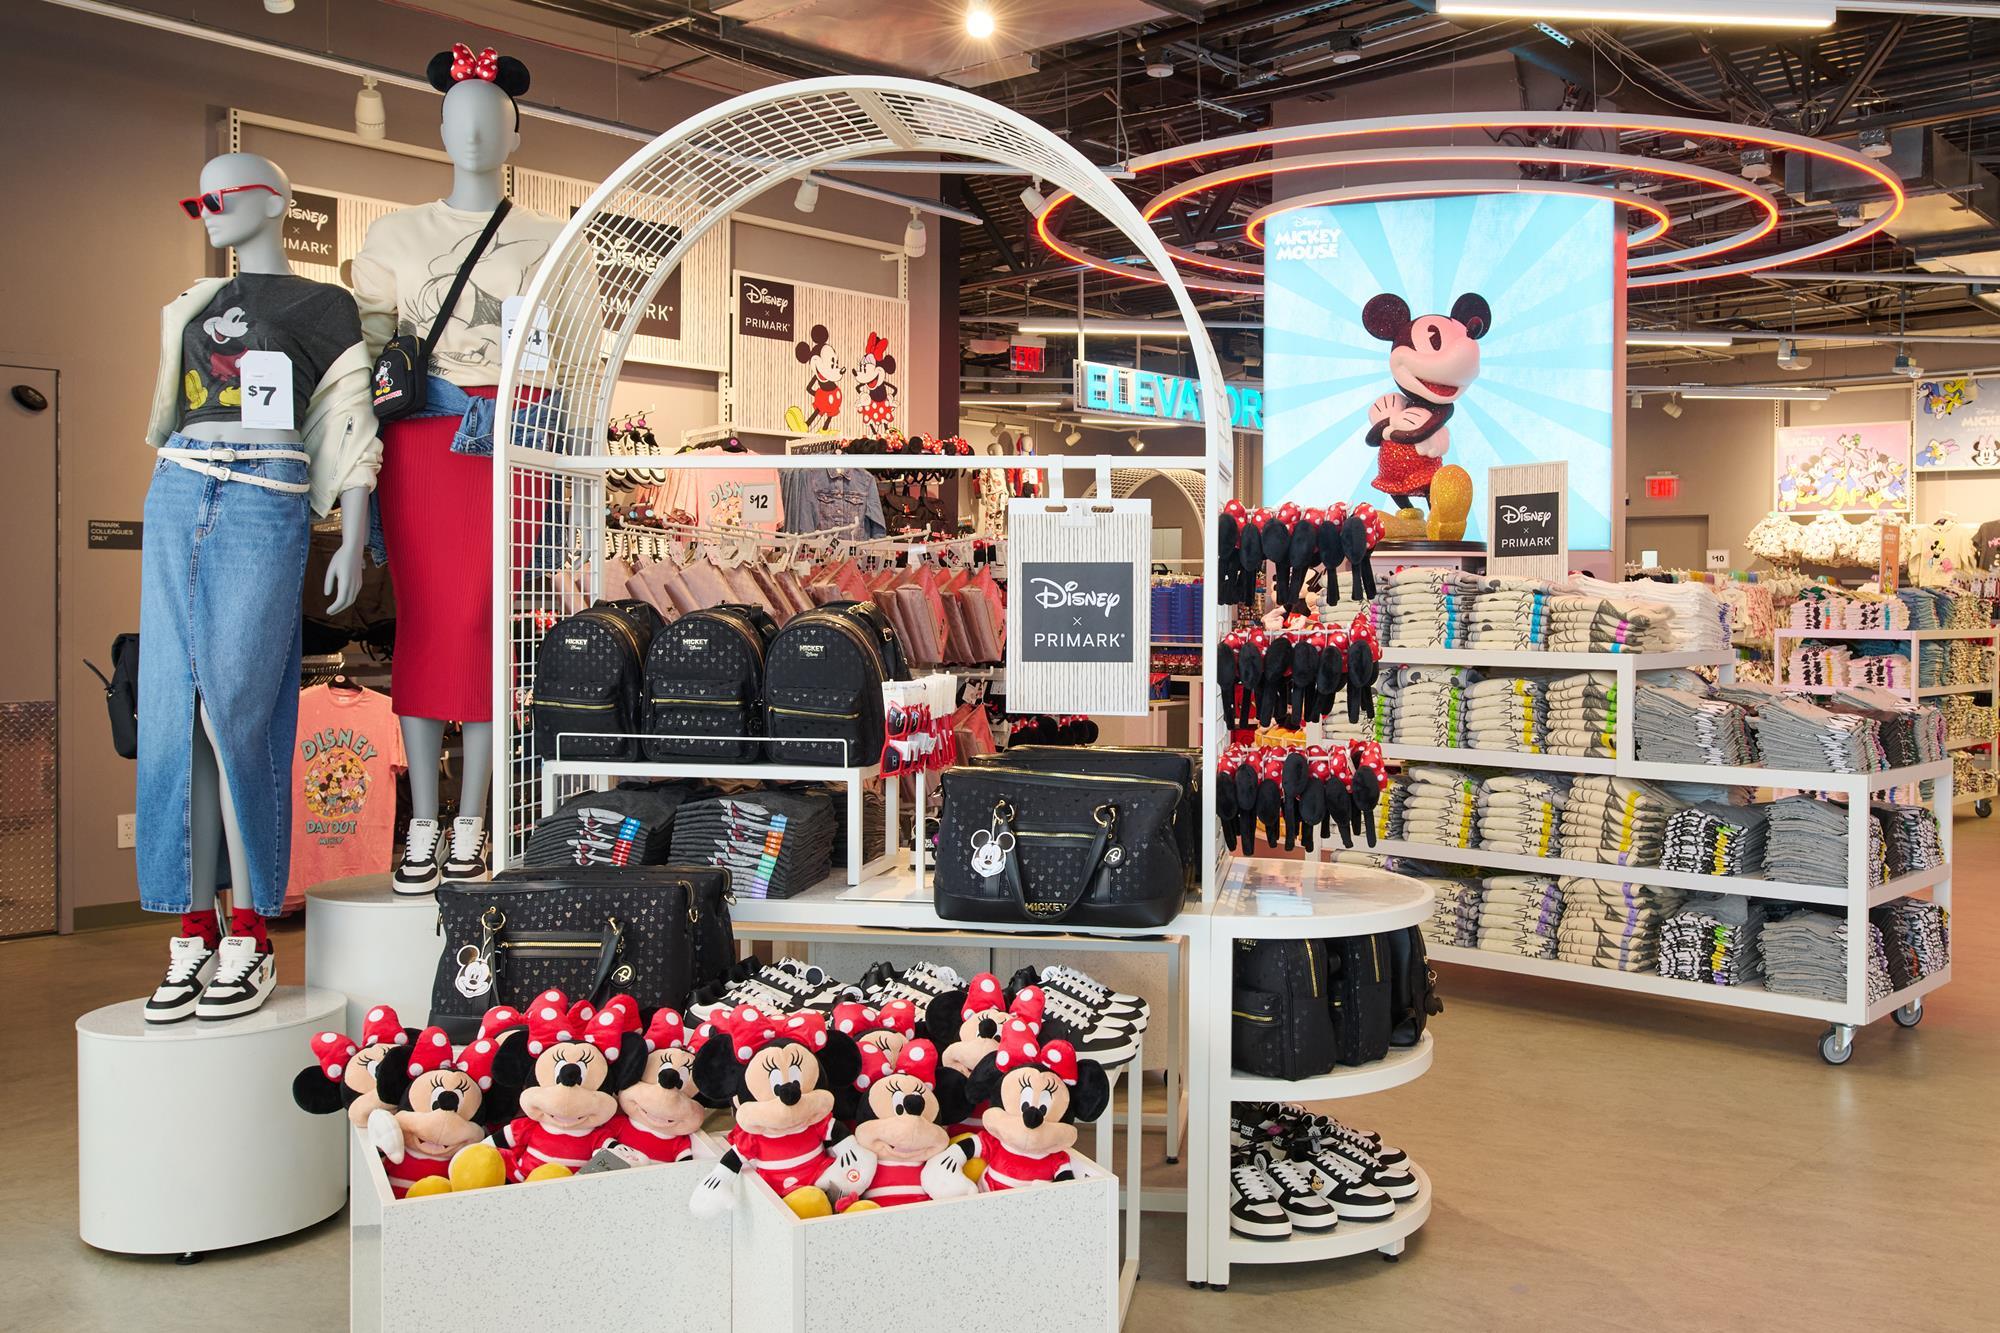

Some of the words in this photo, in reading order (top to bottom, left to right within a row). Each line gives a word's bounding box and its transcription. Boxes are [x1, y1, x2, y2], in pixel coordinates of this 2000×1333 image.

[288, 199, 329, 231] isney
[283, 237, 329, 255] IMARK
[1274, 228, 1342, 246] MICKEY
[1276, 243, 1339, 261] MOUSE
[743, 282, 789, 314] Disney
[745, 317, 788, 332] PRIMARK
[248, 384, 277, 406] $7
[1086, 364, 1264, 430] ELEVAOR
[709, 481, 744, 508] DISN
[1650, 478, 1673, 497] EXIT
[749, 494, 768, 509] $12
[1499, 504, 1552, 528] Disney
[1501, 536, 1552, 548] PRIMARK
[1030, 577, 1120, 618] Disney
[1034, 633, 1120, 648] PRIMARK
[301, 728, 378, 761] DISNEY
[305, 821, 328, 834] DAY
[330, 820, 357, 834] OUT
[1024, 902, 1067, 912] MICKEY
